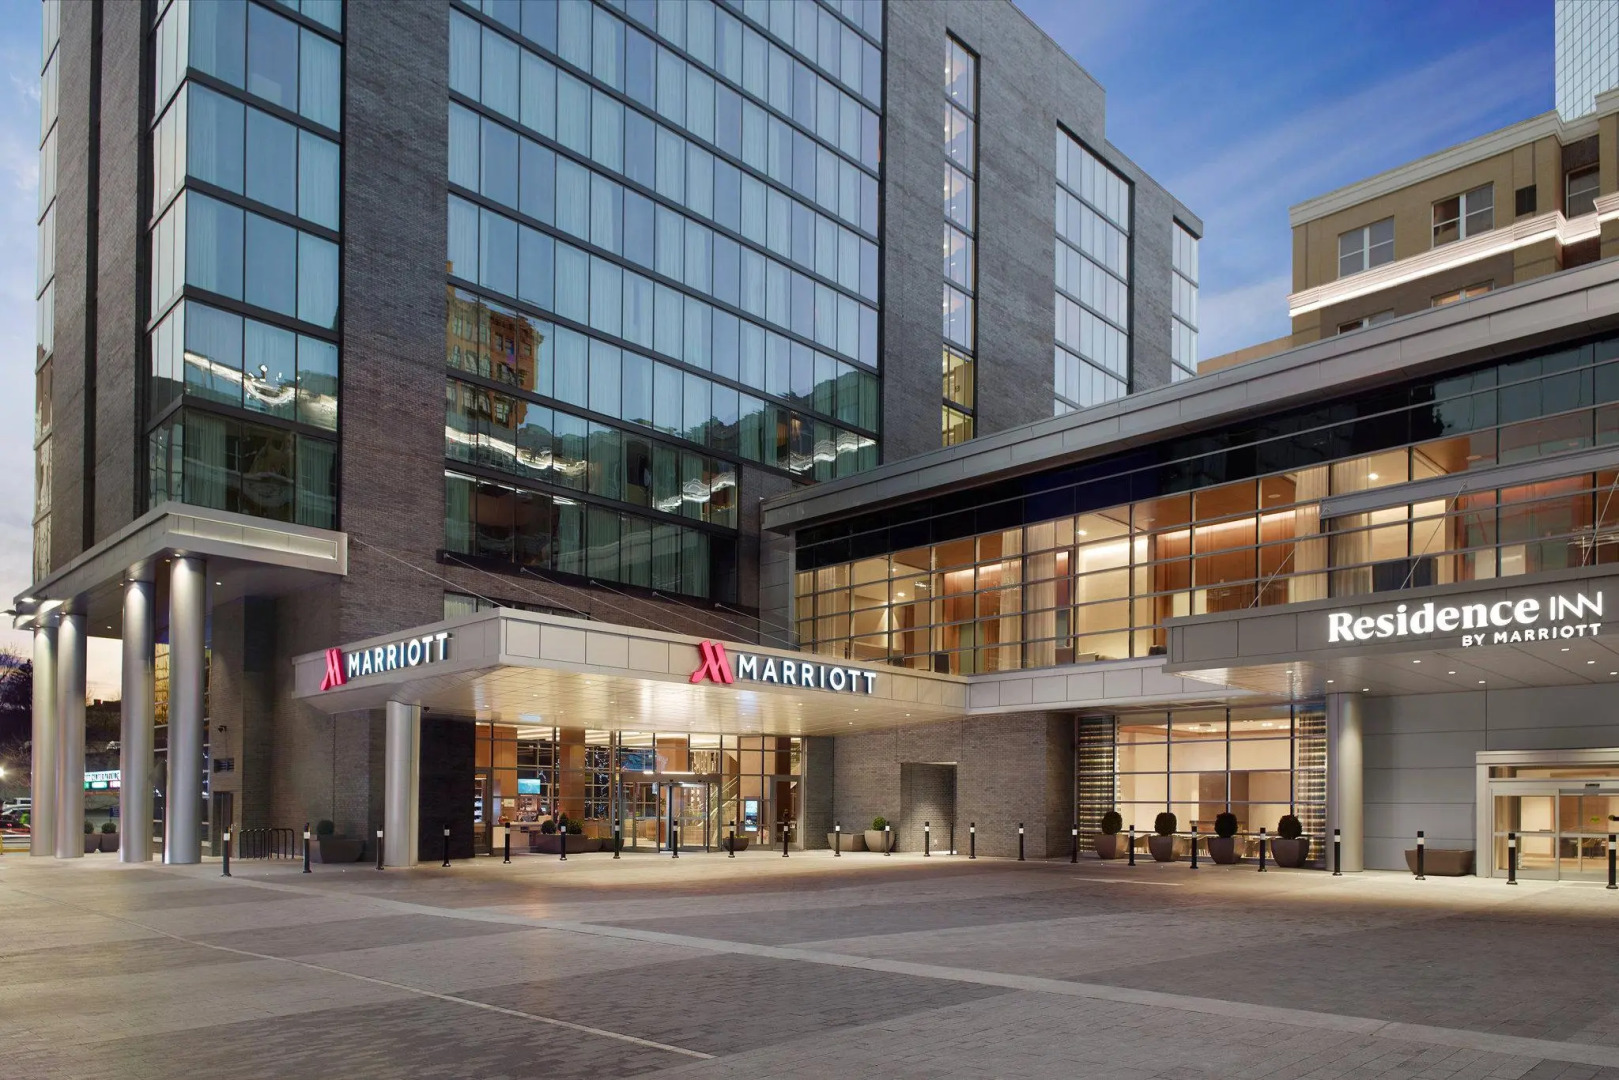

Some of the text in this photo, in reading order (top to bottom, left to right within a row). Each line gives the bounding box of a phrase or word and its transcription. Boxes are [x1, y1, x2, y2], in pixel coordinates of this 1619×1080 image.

[1328, 591, 1603, 642] Residence INN
[1462, 623, 1602, 648] BY MARRIOTT
[348, 632, 448, 678] MARRIOTT
[737, 654, 877, 694] MARRIOTT
